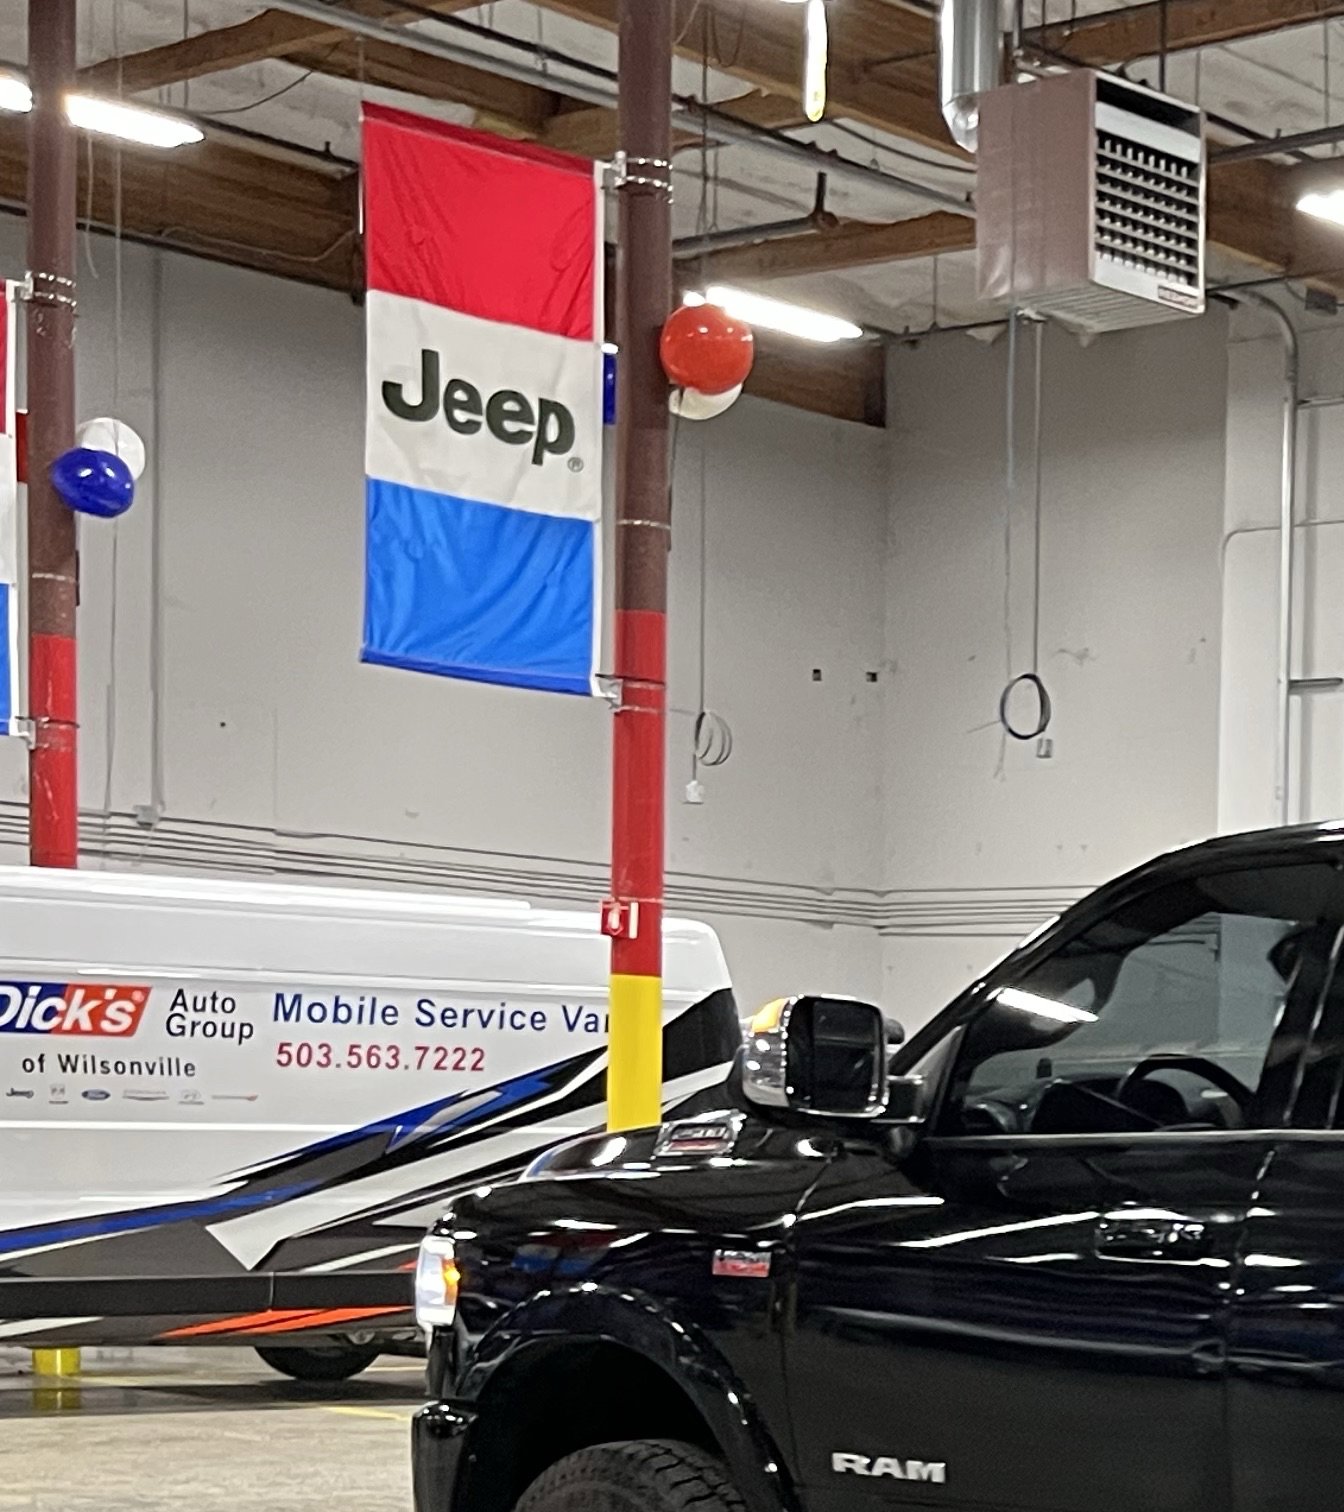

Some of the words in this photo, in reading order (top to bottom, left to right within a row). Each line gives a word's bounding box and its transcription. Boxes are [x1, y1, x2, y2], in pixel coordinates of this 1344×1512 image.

[382, 348, 576, 466] Jeep
[169, 988, 236, 1015] Auto
[273, 992, 399, 1026] Mobile
[415, 998, 547, 1031] Service
[561, 1004, 610, 1034] Va
[165, 1012, 254, 1045] Group
[22, 1053, 45, 1074] of
[57, 1053, 196, 1077] Wilsonville
[276, 1042, 486, 1072] 503.563.7222
[831, 1451, 947, 1484] RAM
